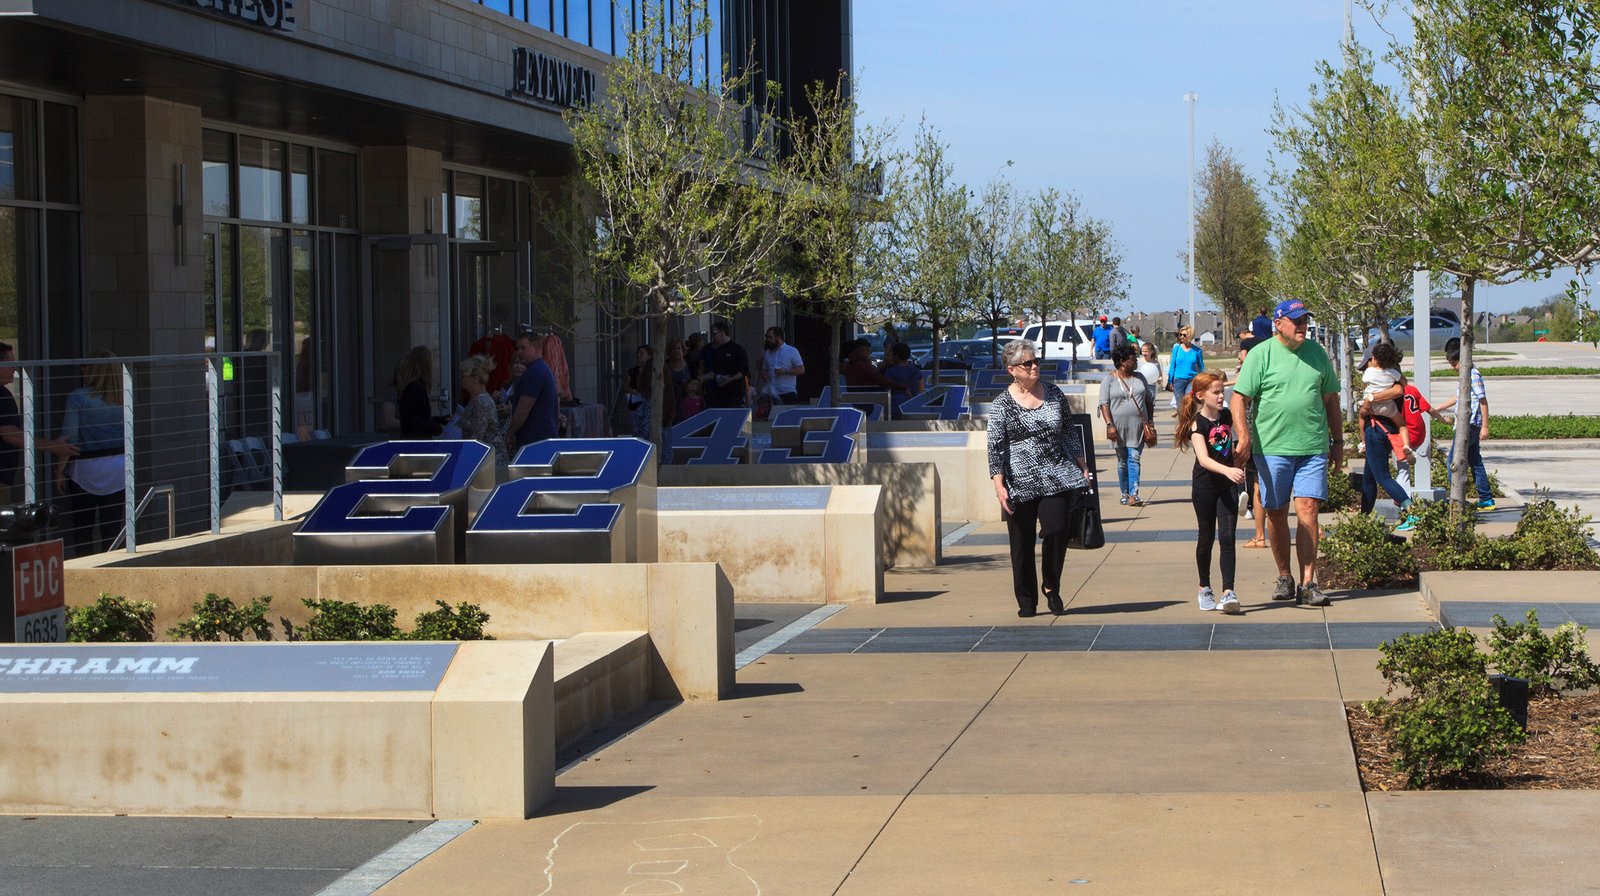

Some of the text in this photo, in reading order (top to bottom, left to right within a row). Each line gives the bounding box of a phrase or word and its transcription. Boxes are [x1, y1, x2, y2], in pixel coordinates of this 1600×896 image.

[293, 438, 655, 534] 22
[20, 555, 59, 601] FDC
[24, 614, 59, 643] 6635
